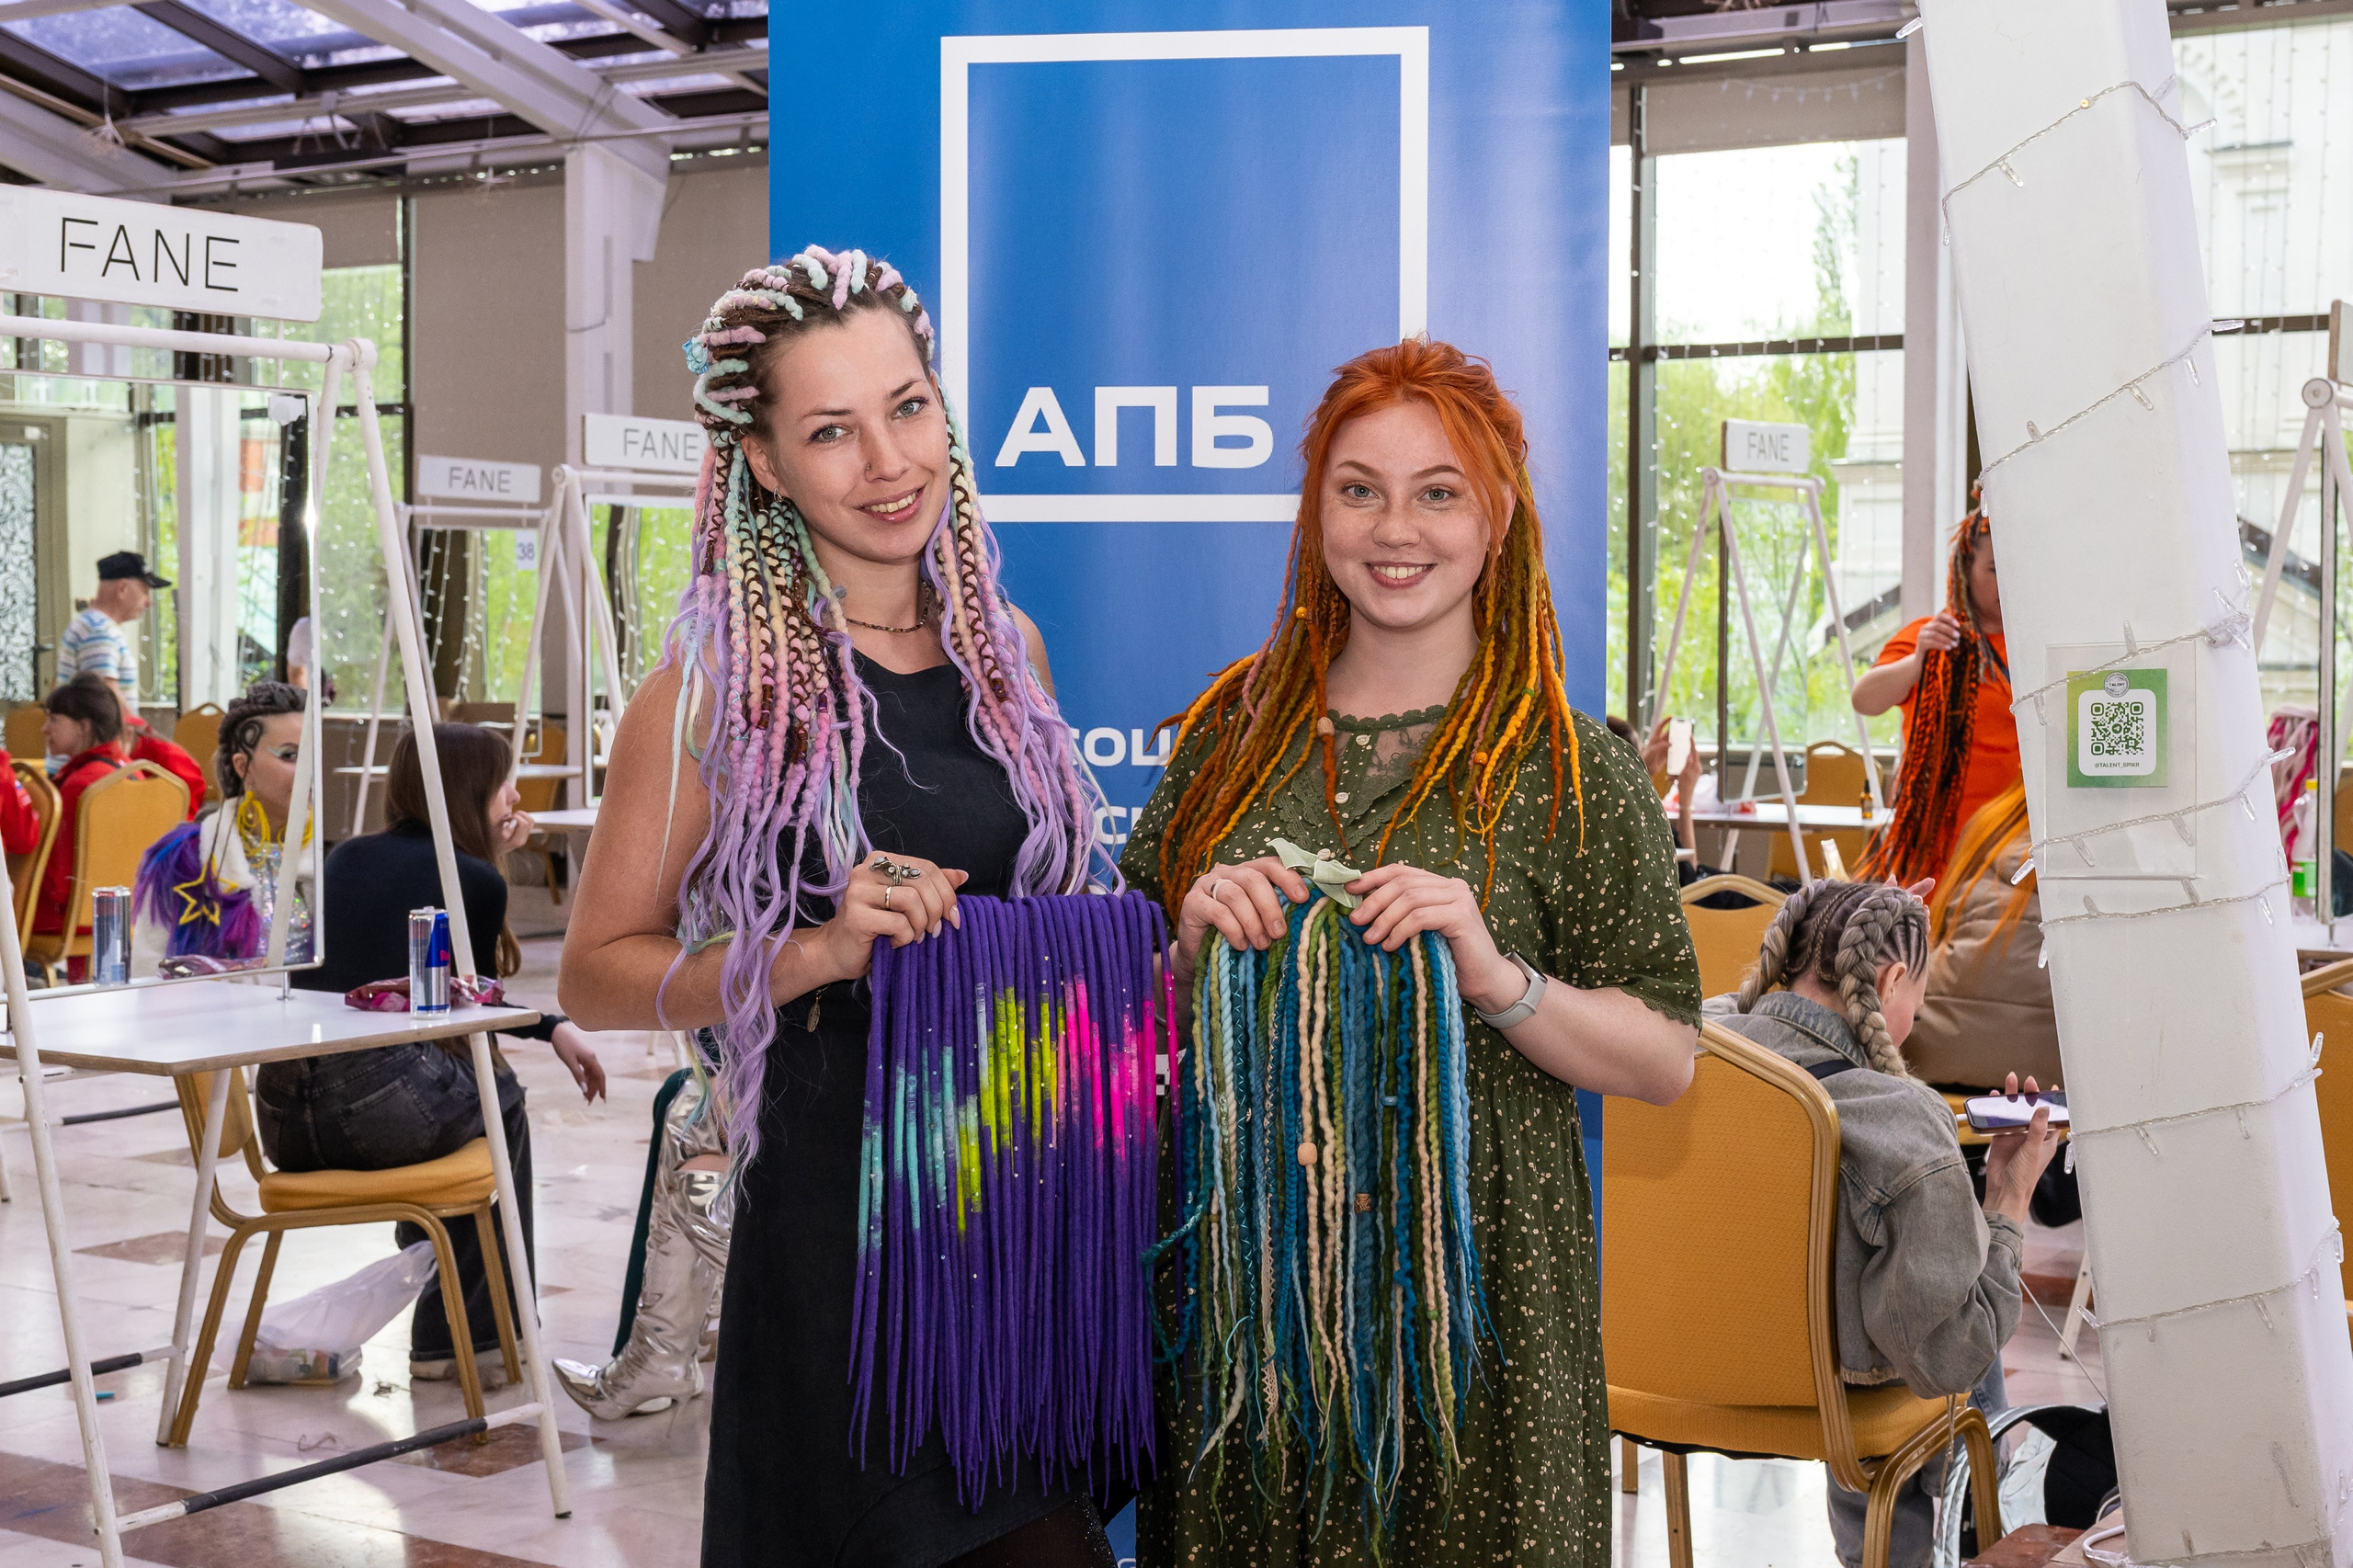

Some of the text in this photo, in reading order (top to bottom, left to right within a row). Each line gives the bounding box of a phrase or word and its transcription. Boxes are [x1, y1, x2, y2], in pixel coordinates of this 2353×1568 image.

[61, 217, 240, 291] FANE
[623, 427, 699, 461] FANE
[995, 385, 1274, 469] АПБ
[1747, 431, 1790, 462] FANE
[449, 465, 511, 494] FANE
